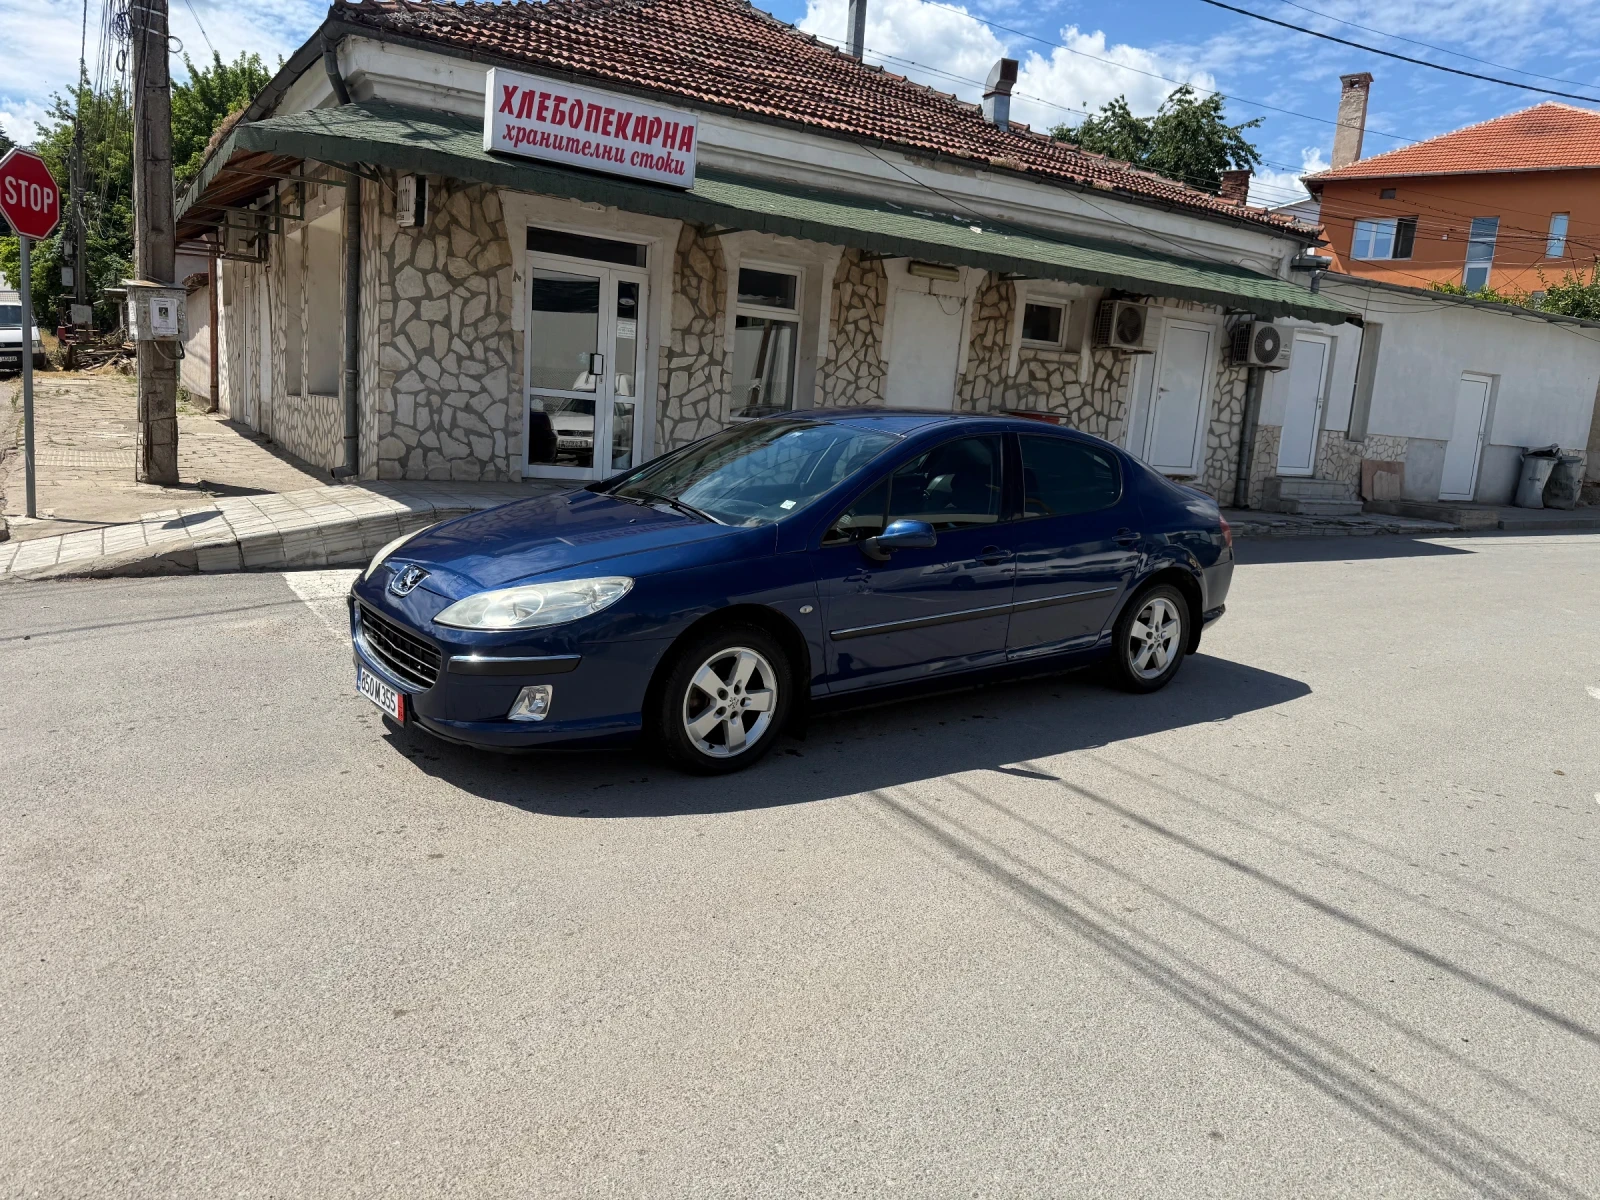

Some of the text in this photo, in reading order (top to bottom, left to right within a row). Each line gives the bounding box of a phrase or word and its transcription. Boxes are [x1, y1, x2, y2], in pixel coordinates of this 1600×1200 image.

[499, 85, 695, 152] ХЛЕБОПЕКАРНА
[502, 124, 685, 175] хранителни стоки
[5, 176, 53, 213] STOP
